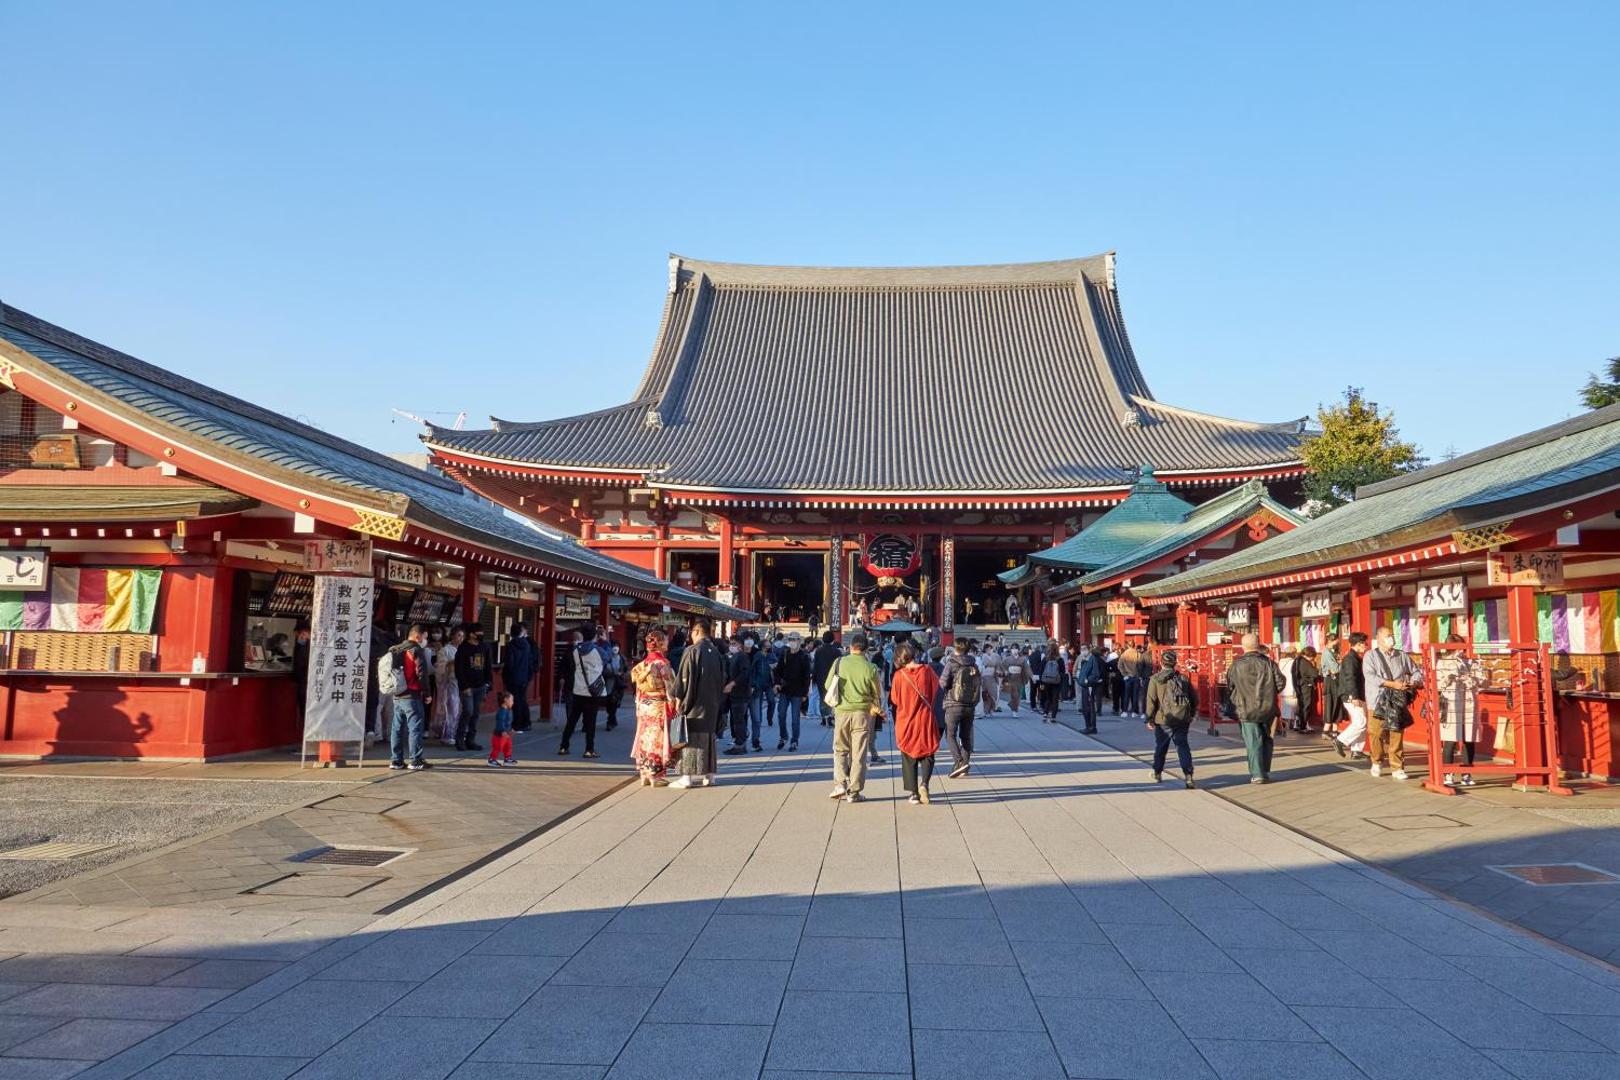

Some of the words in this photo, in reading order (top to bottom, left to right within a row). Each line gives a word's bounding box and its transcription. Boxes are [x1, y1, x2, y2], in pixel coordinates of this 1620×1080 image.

[389, 565, 420, 582] お札お守
[1513, 553, 1559, 574] 朱印所
[1423, 579, 1461, 606] みくじ
[331, 585, 352, 703] 救援募金受付中
[351, 585, 369, 703] ウクライナ人道危機
